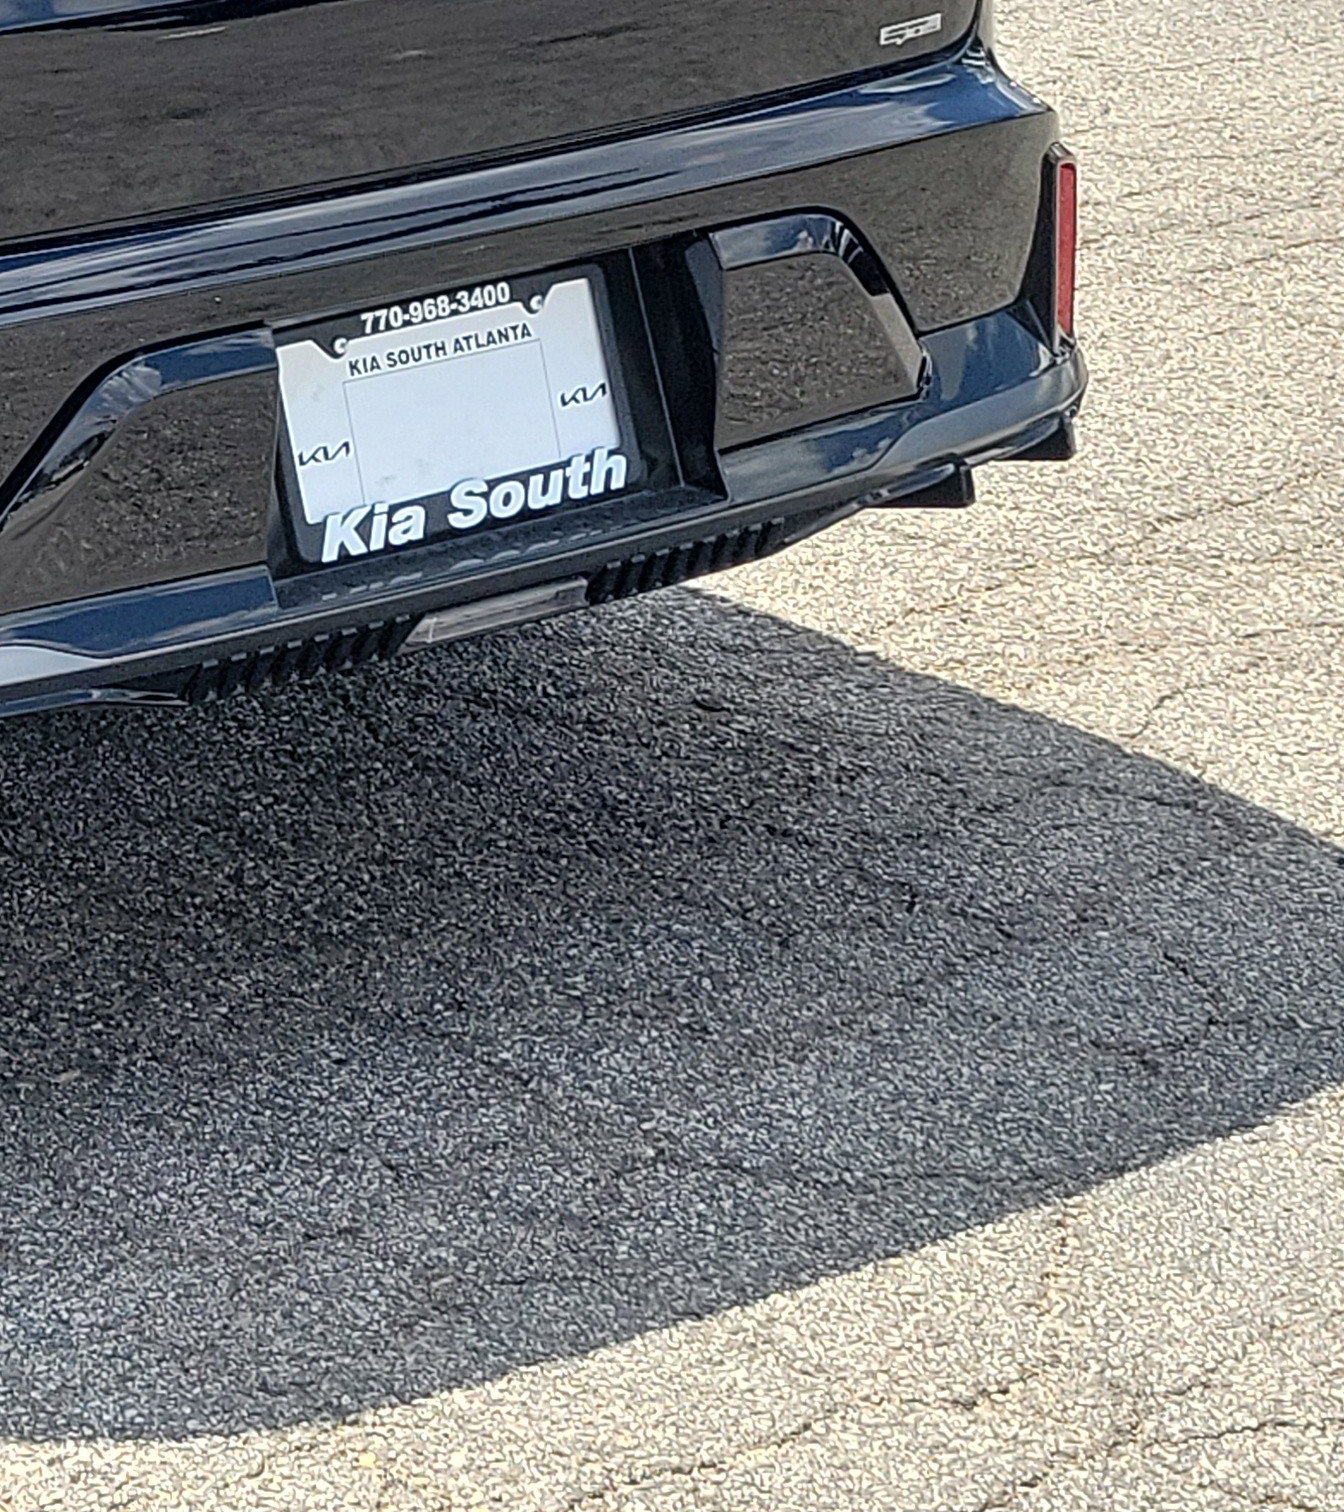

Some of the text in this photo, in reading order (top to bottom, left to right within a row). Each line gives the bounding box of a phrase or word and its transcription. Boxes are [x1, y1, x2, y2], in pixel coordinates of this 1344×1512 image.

[360, 281, 511, 335] 770-968-3400
[348, 322, 533, 377] KIA SOUTH ATLANTA
[321, 447, 628, 564] Kia South
